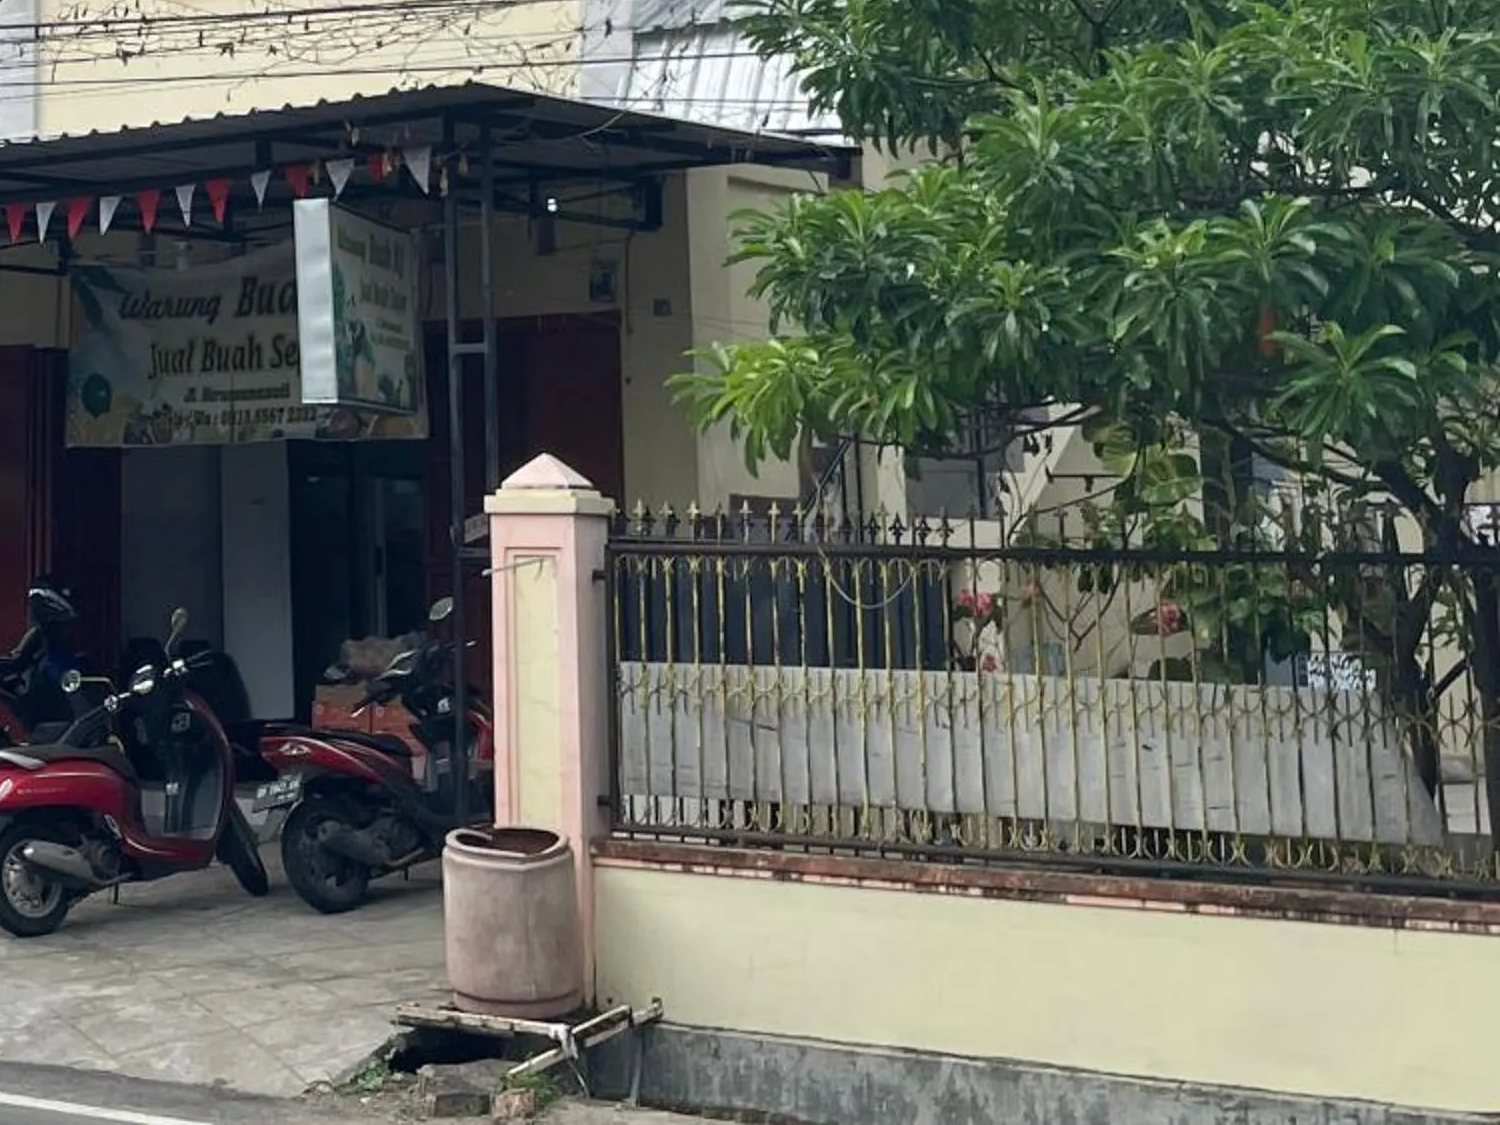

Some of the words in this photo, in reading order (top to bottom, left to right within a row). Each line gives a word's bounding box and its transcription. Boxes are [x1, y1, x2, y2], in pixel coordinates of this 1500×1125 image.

[118, 288, 222, 325] Warung
[147, 336, 197, 380] Jual
[201, 333, 263, 372] Buah
